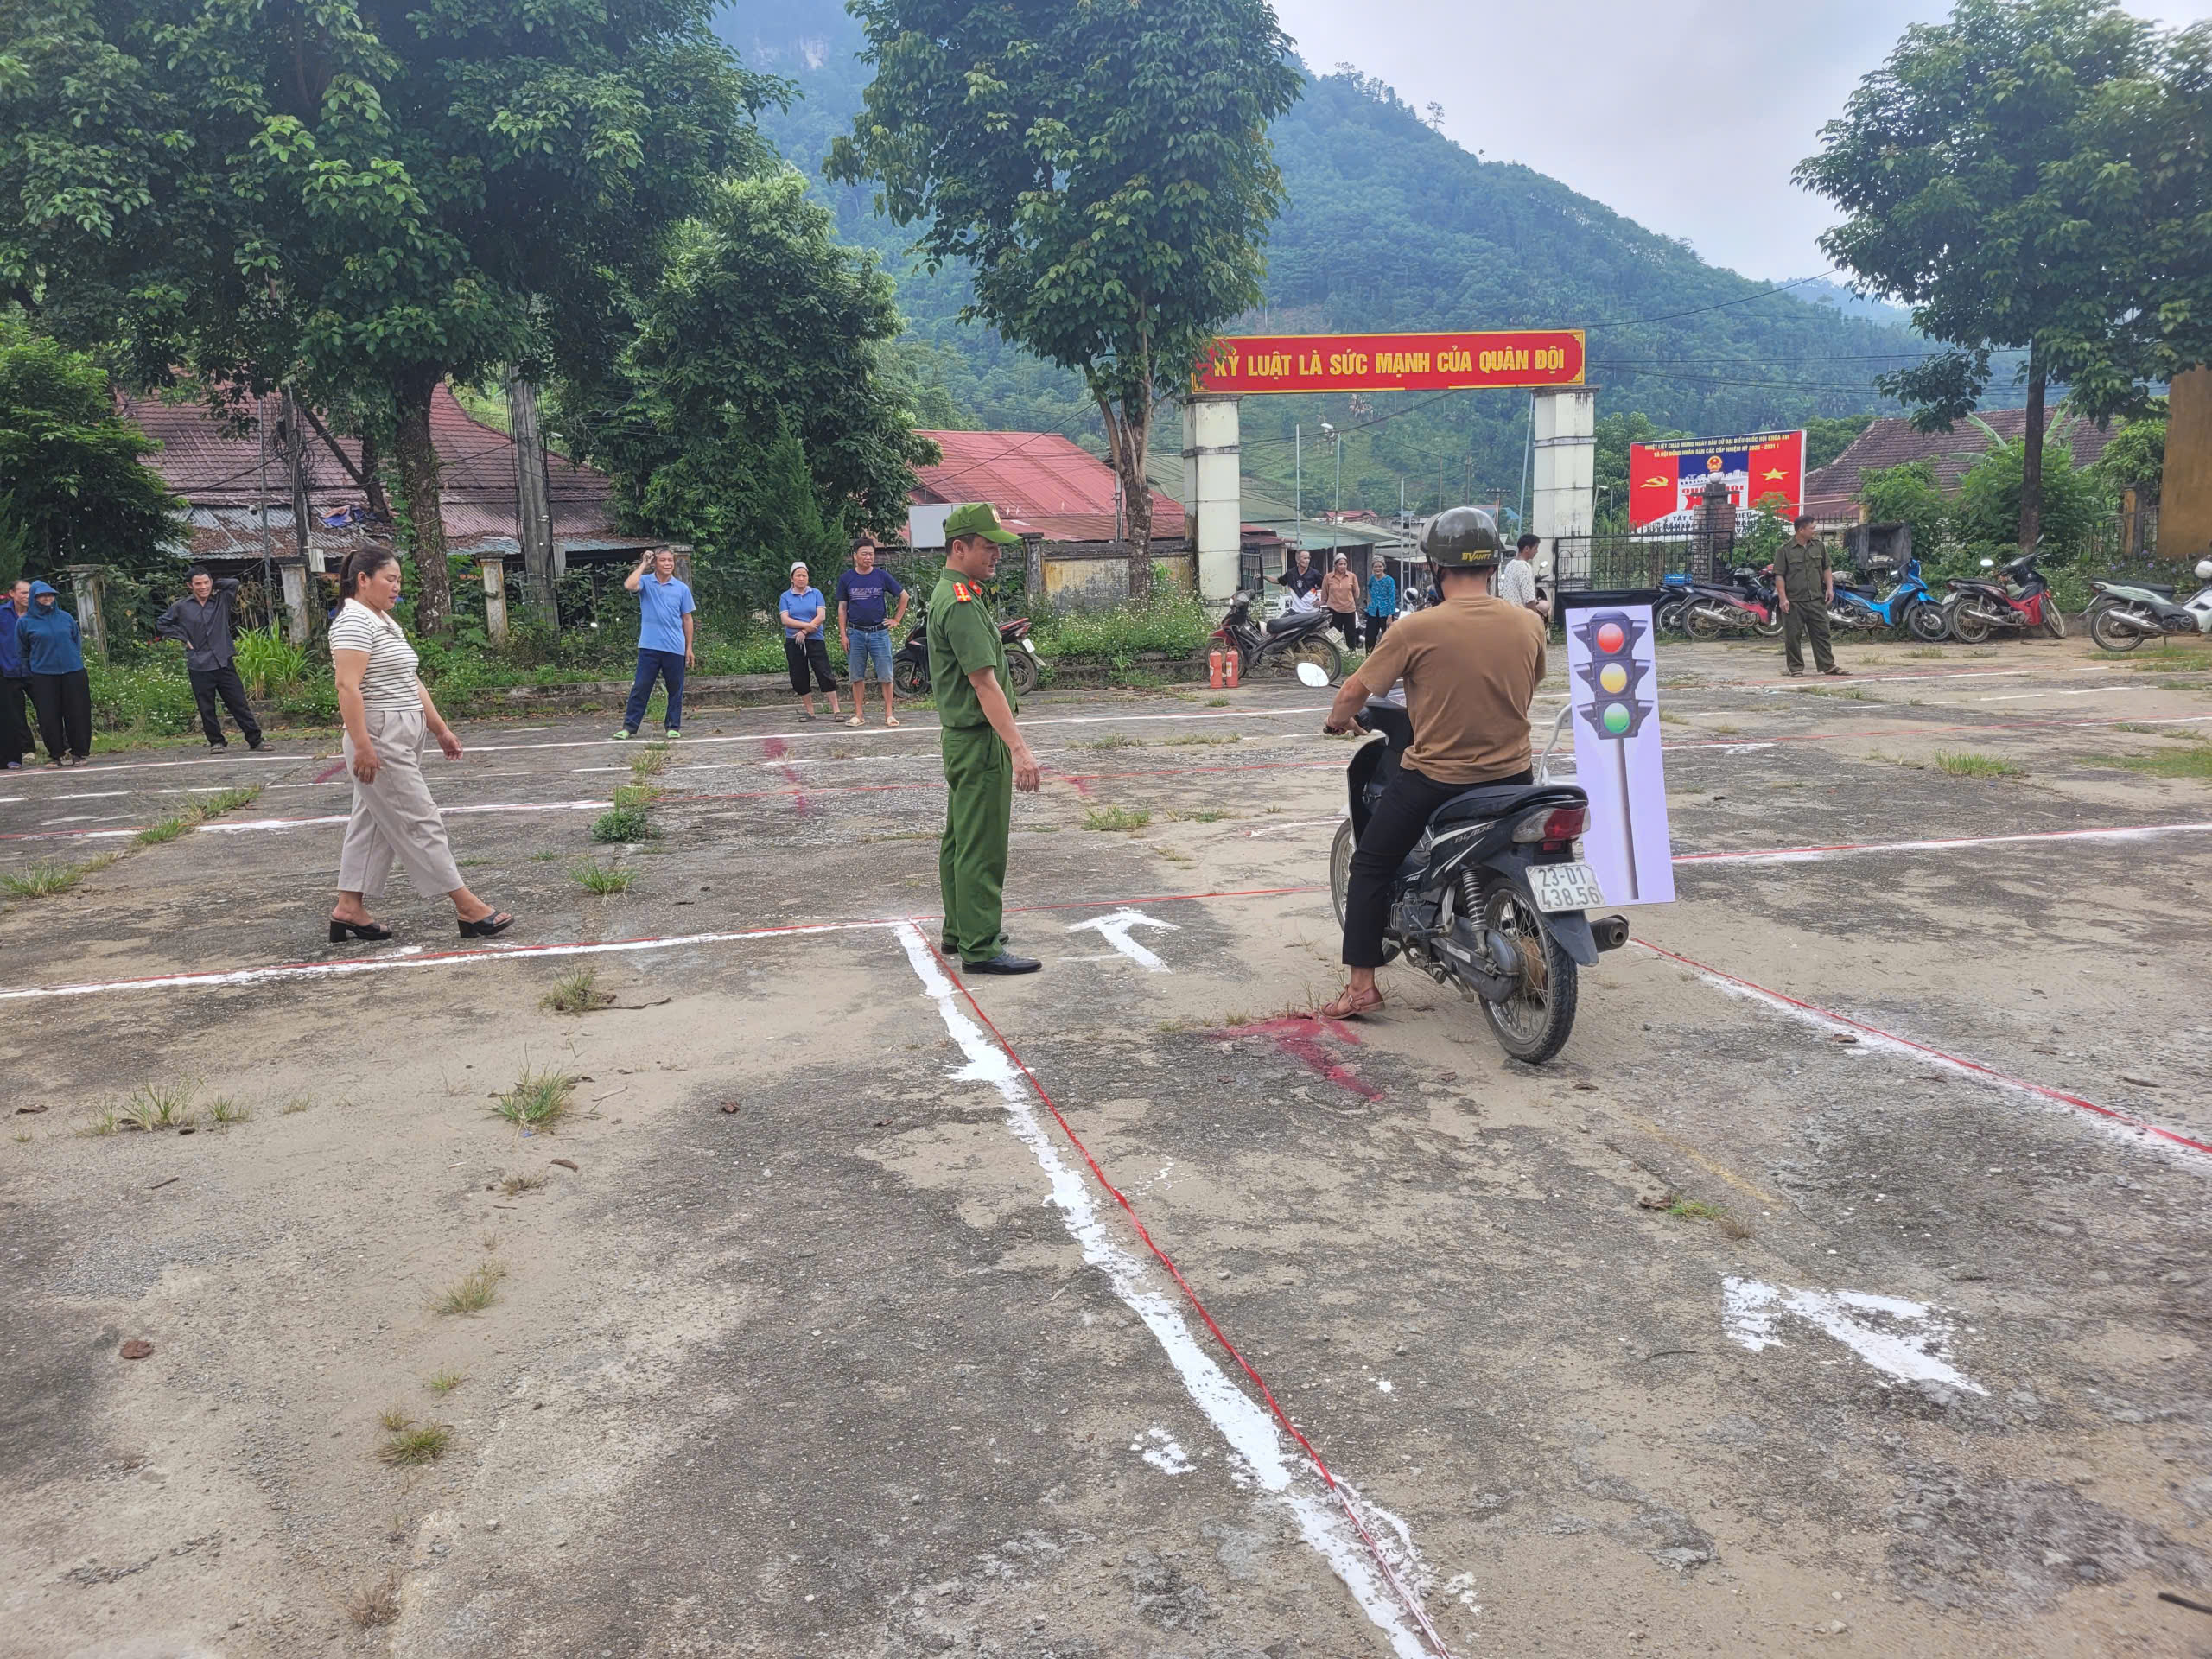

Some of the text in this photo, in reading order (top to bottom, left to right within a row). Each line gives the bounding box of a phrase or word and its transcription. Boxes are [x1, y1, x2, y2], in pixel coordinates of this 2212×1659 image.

[1214, 345, 1565, 380] KỶ LUẬT LÀ SỨC MẠNH CỦA QUÂN ĐỘI
[1454, 823, 1496, 843] BLADE
[1538, 867, 1586, 887] 23-D1
[1541, 887, 1600, 907] 438.56
